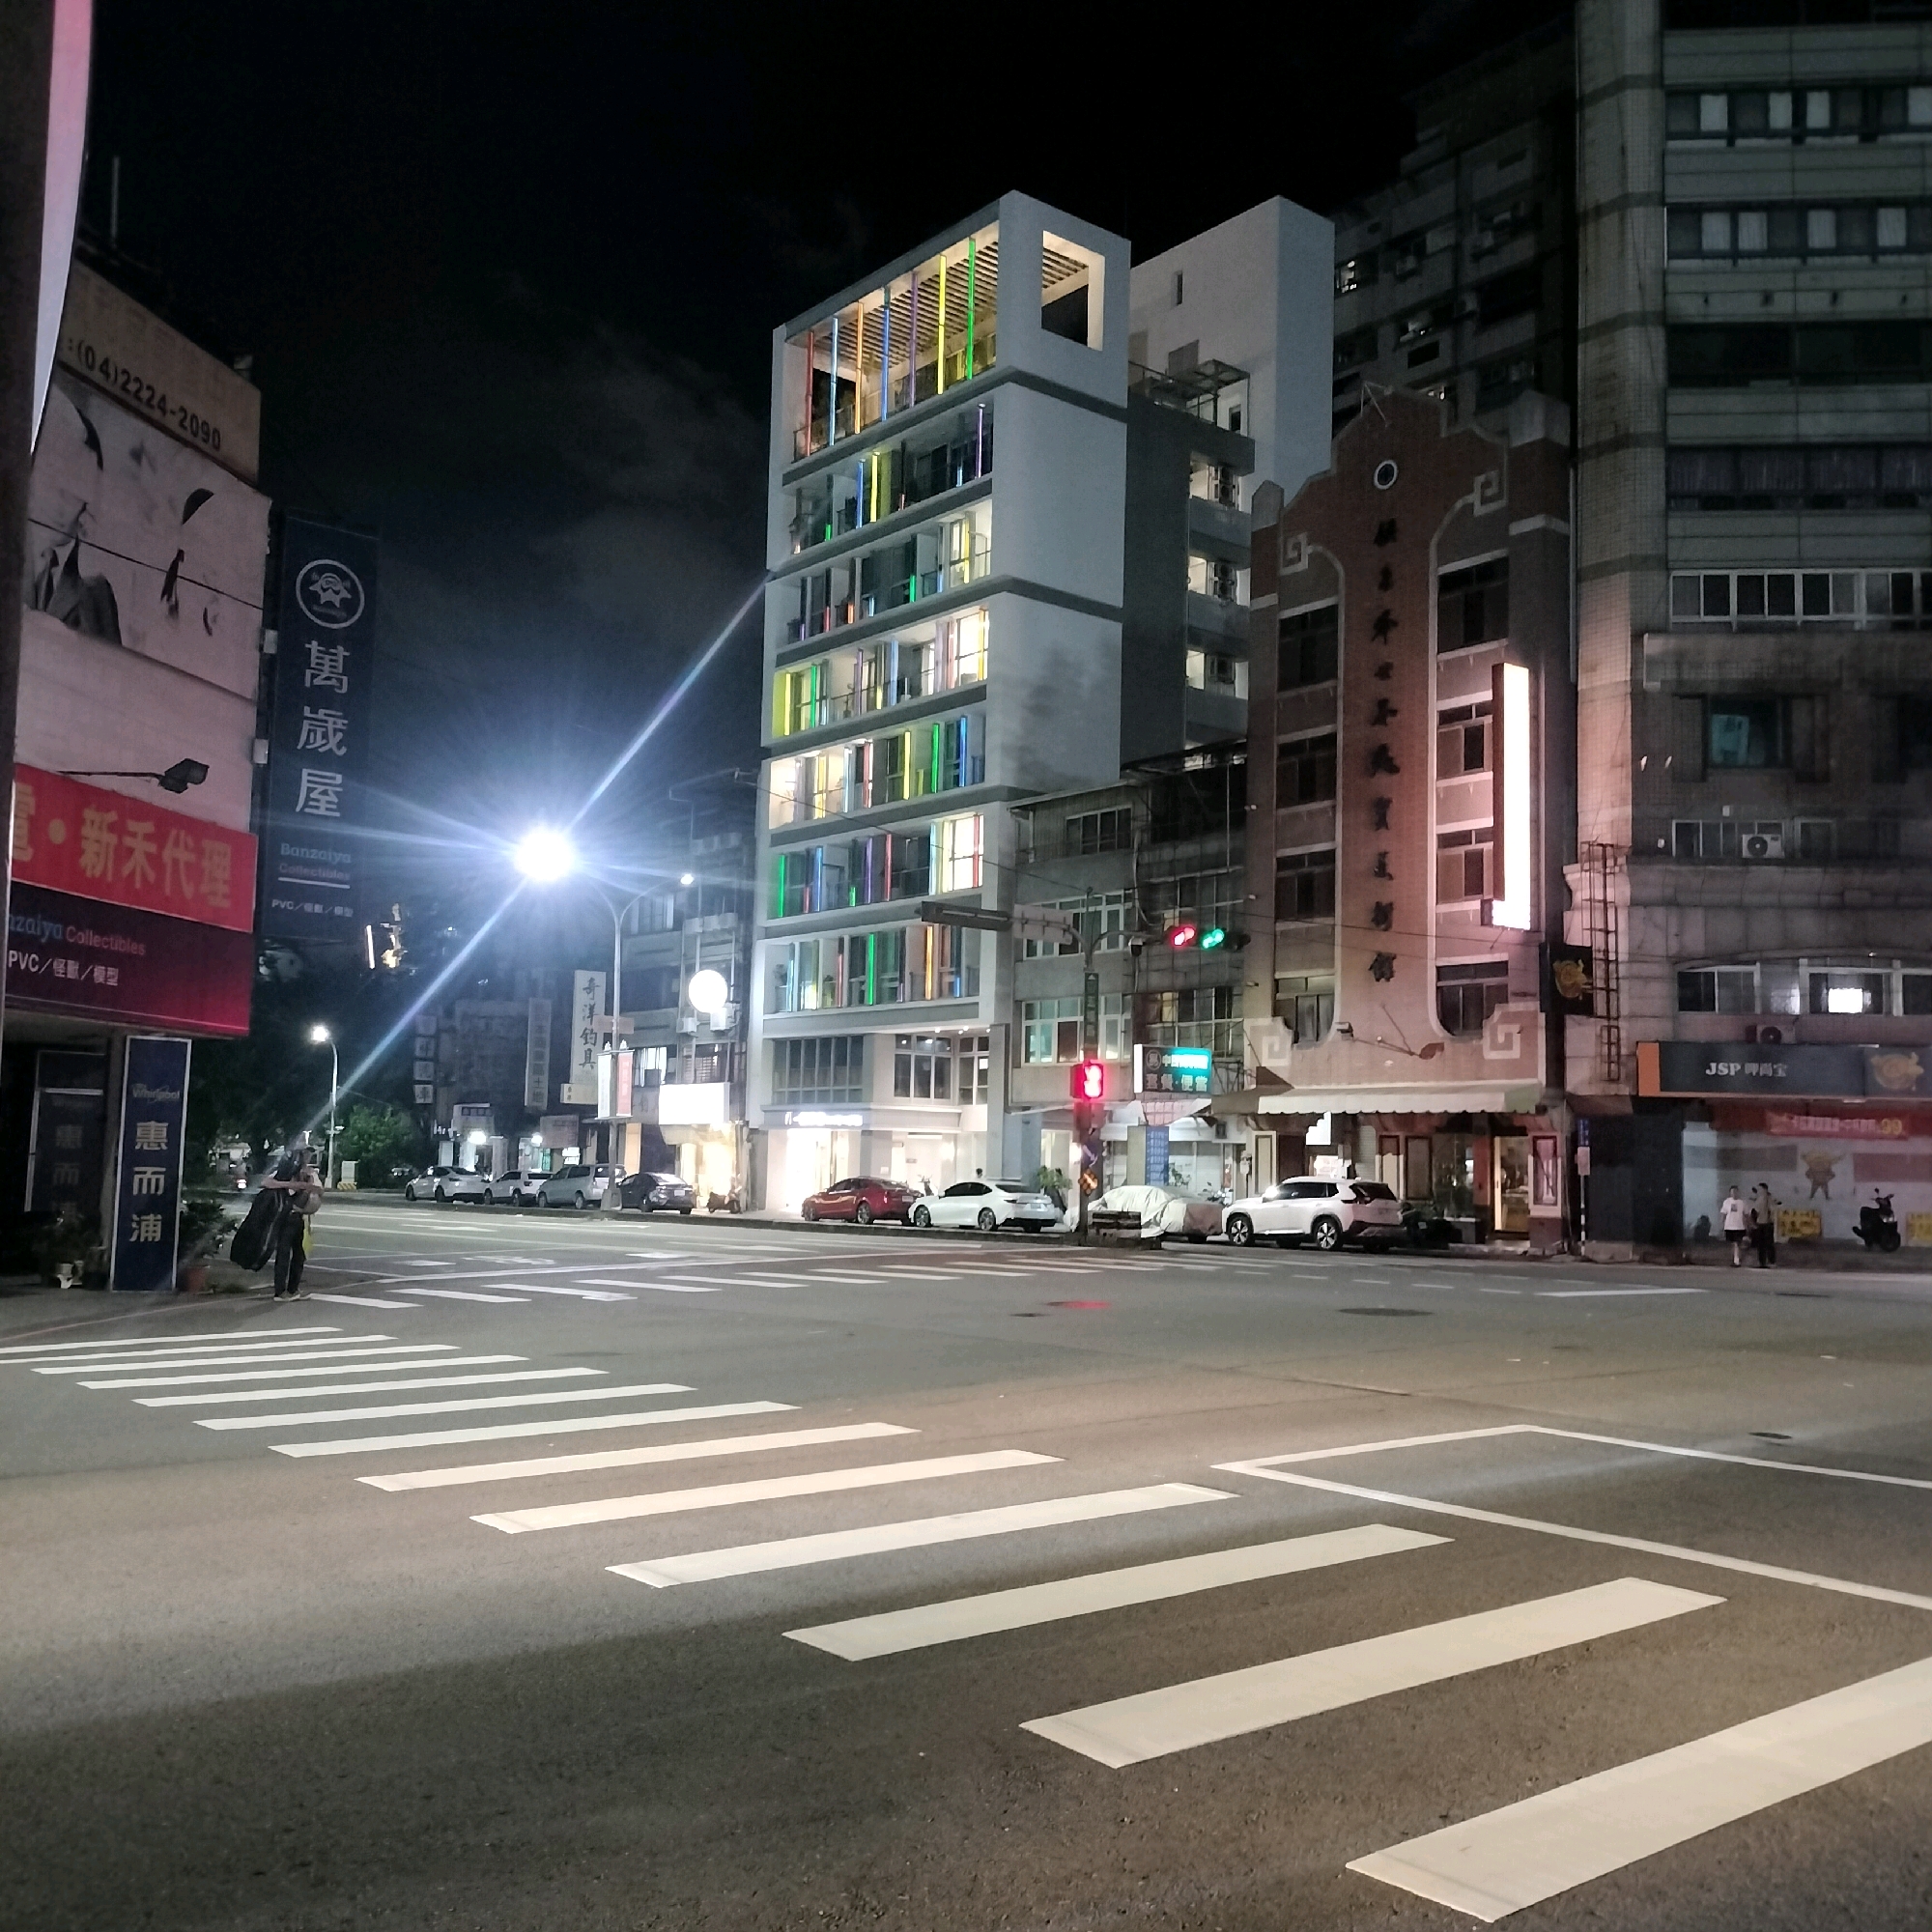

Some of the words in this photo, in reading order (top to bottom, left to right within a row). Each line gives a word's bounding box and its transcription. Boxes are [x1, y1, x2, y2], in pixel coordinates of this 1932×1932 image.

[296, 640, 350, 817] 萬歲屋
[280, 842, 352, 865] Banzaiya
[66, 925, 146, 955] Collectibles
[1705, 1062, 1742, 1077] JSP
[129, 1121, 169, 1242] 惠而浦
